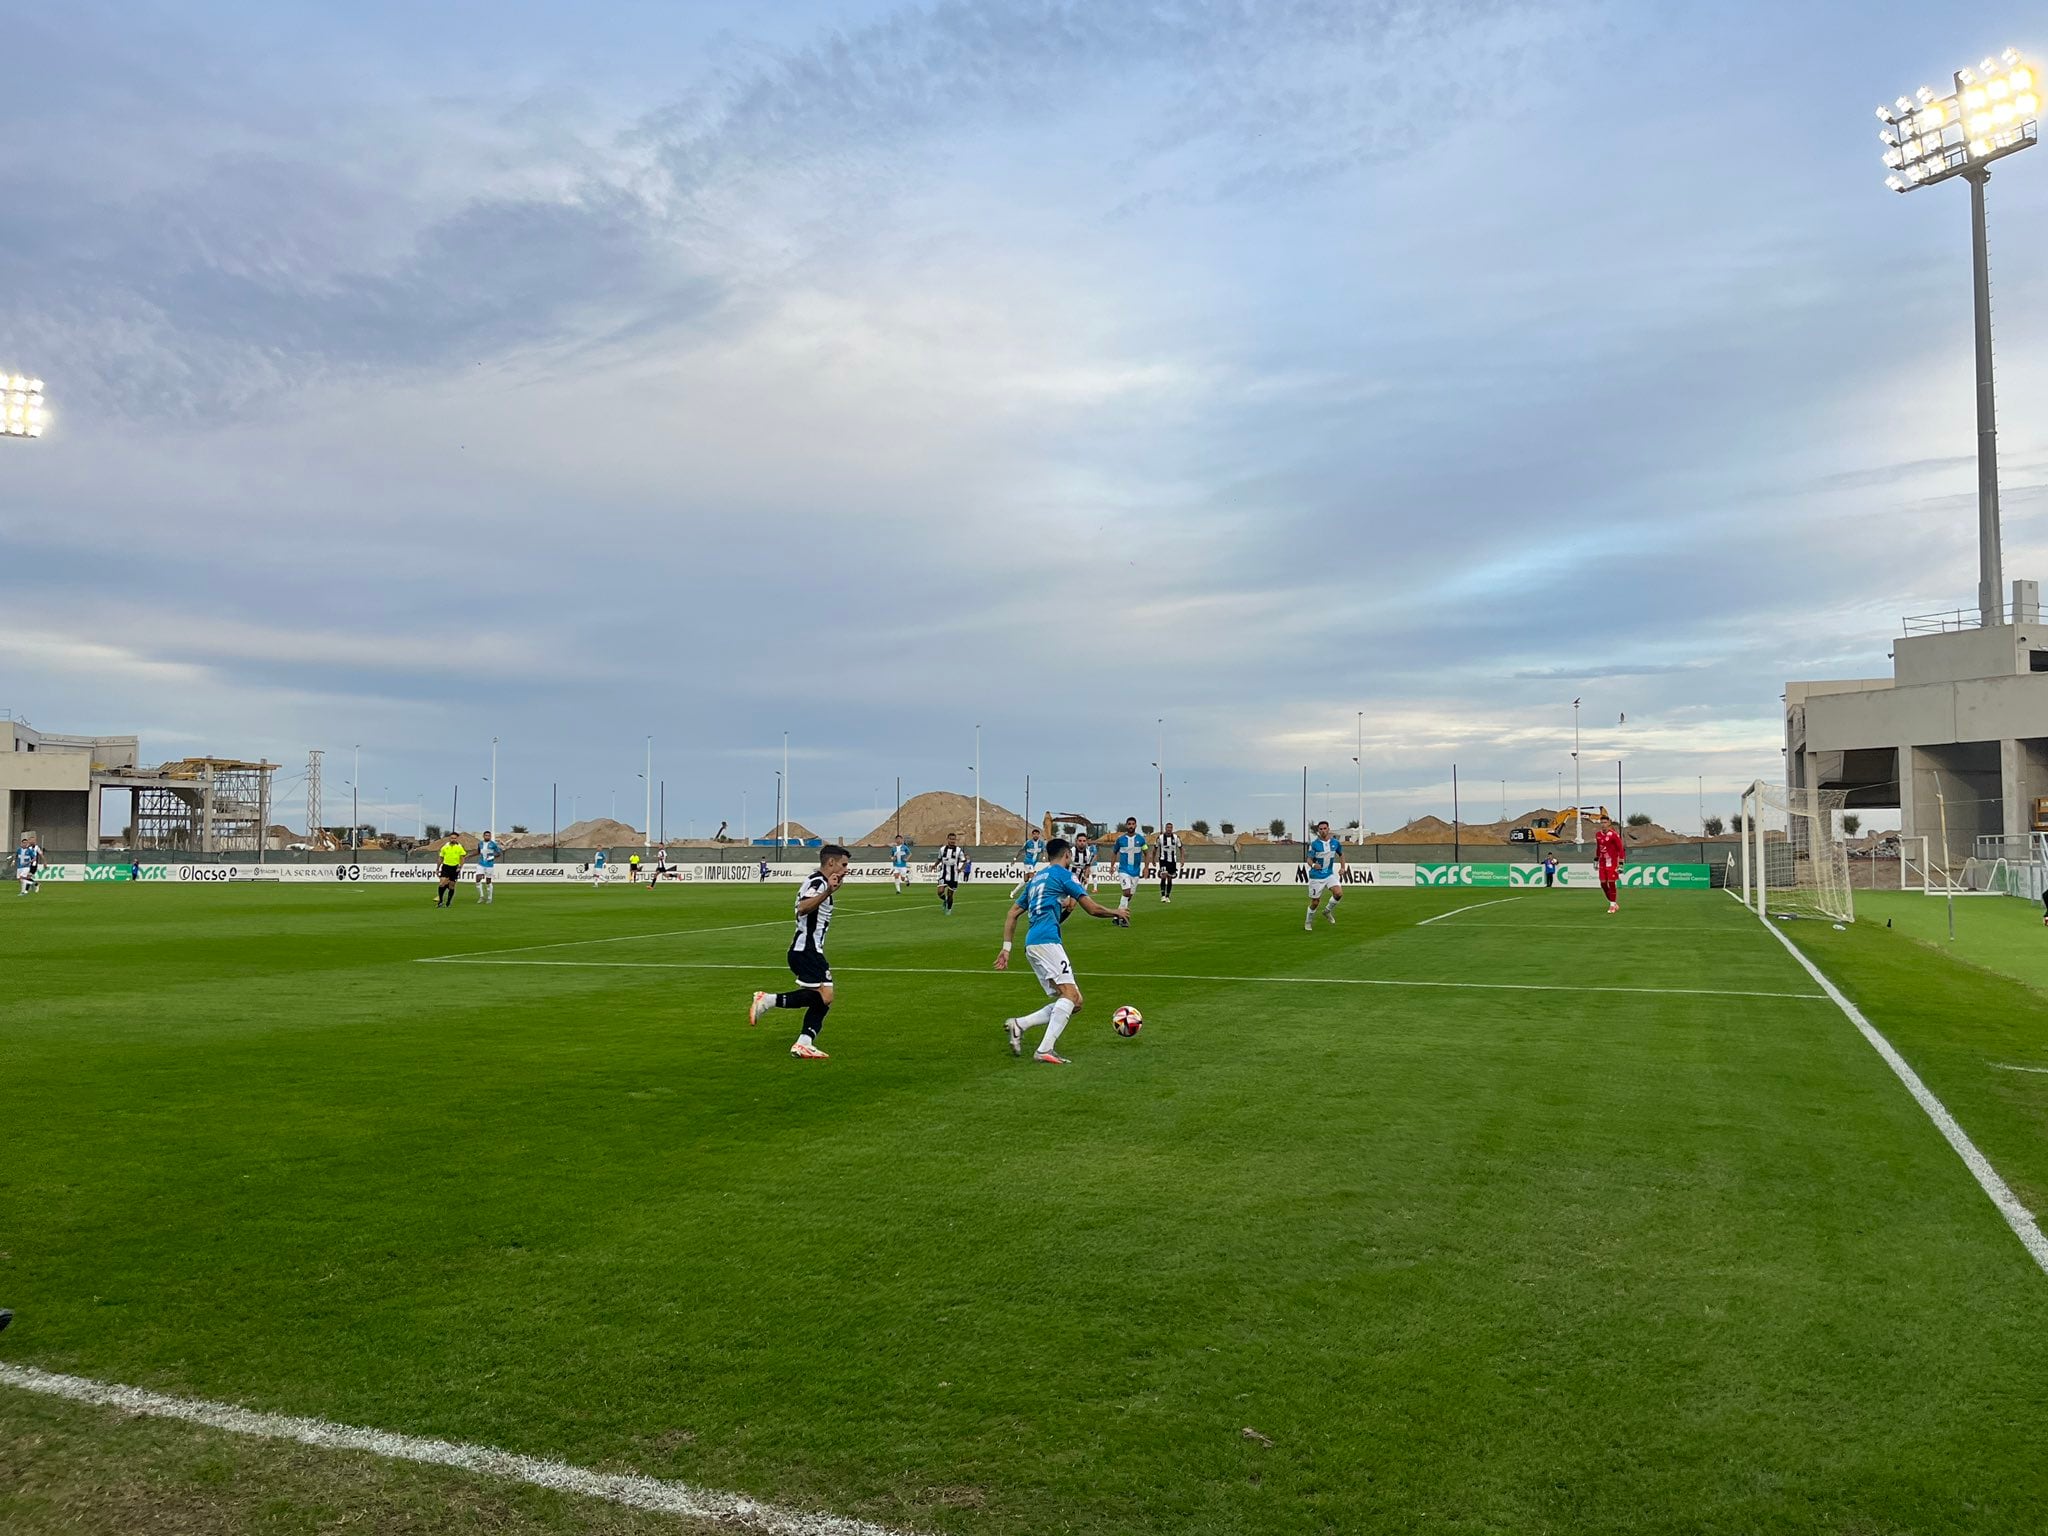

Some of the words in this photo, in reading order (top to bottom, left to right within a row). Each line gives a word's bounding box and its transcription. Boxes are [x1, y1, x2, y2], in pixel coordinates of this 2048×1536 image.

[704, 866, 751, 880] IMPULSO27
[975, 865, 1024, 878] freekick
[1214, 872, 1281, 883] BARROSO
[1061, 961, 1070, 974] 2
